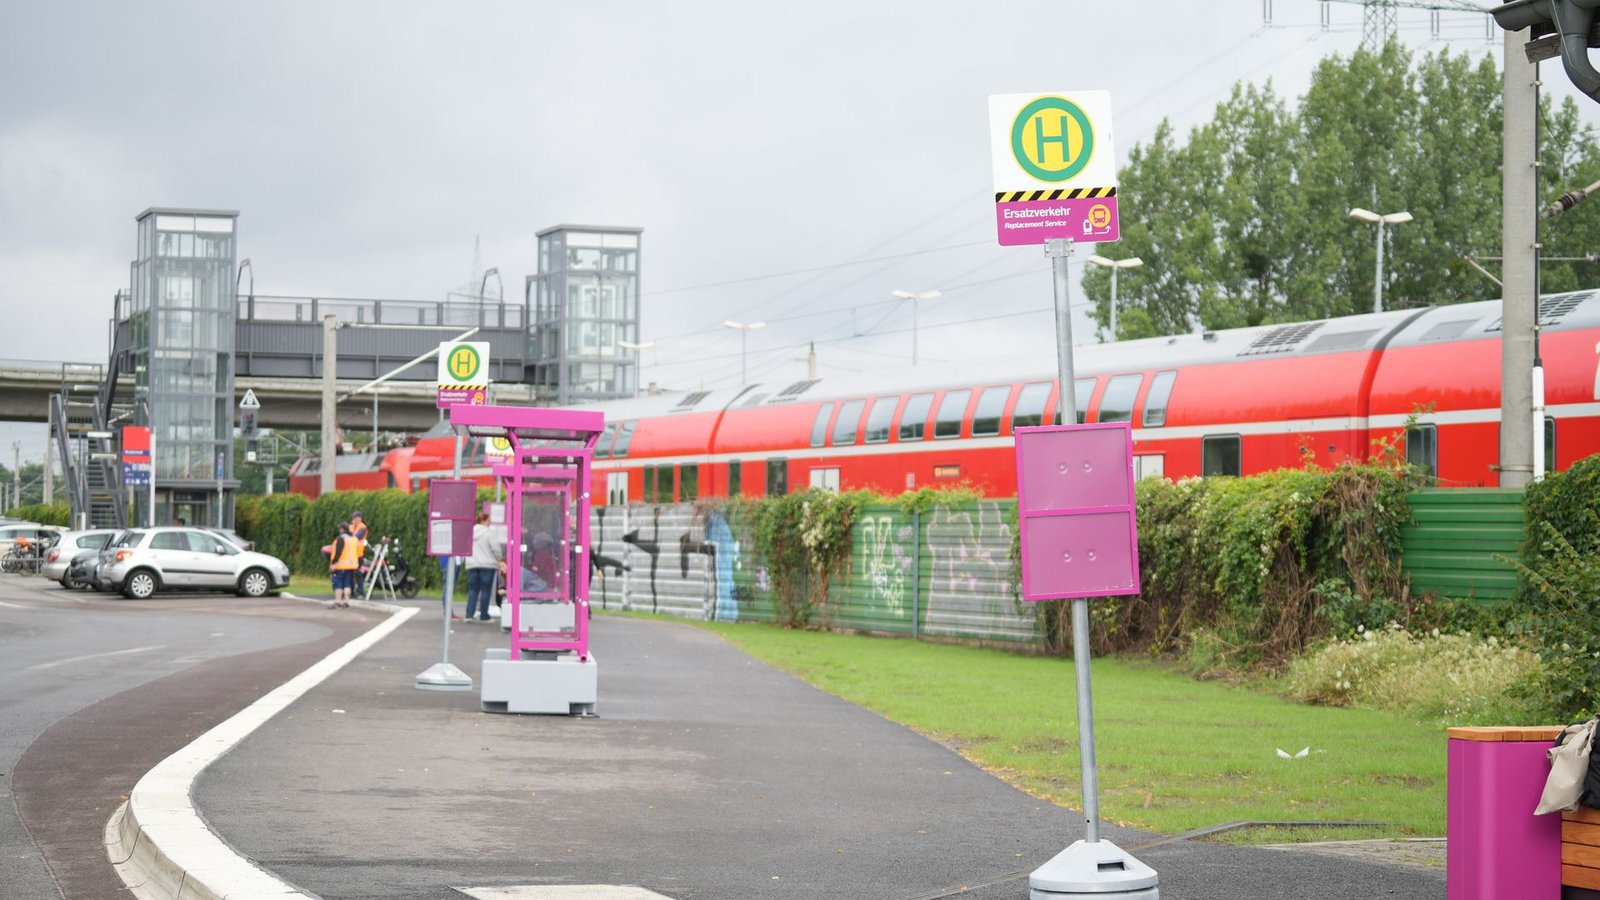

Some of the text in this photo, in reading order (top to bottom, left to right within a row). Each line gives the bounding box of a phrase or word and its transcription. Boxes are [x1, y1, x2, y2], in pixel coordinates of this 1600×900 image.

[1035, 115, 1070, 163] H
[1003, 206, 1071, 218] Ersatzverkehr
[1004, 221, 1044, 229] Replacement
[457, 352, 471, 373] H
